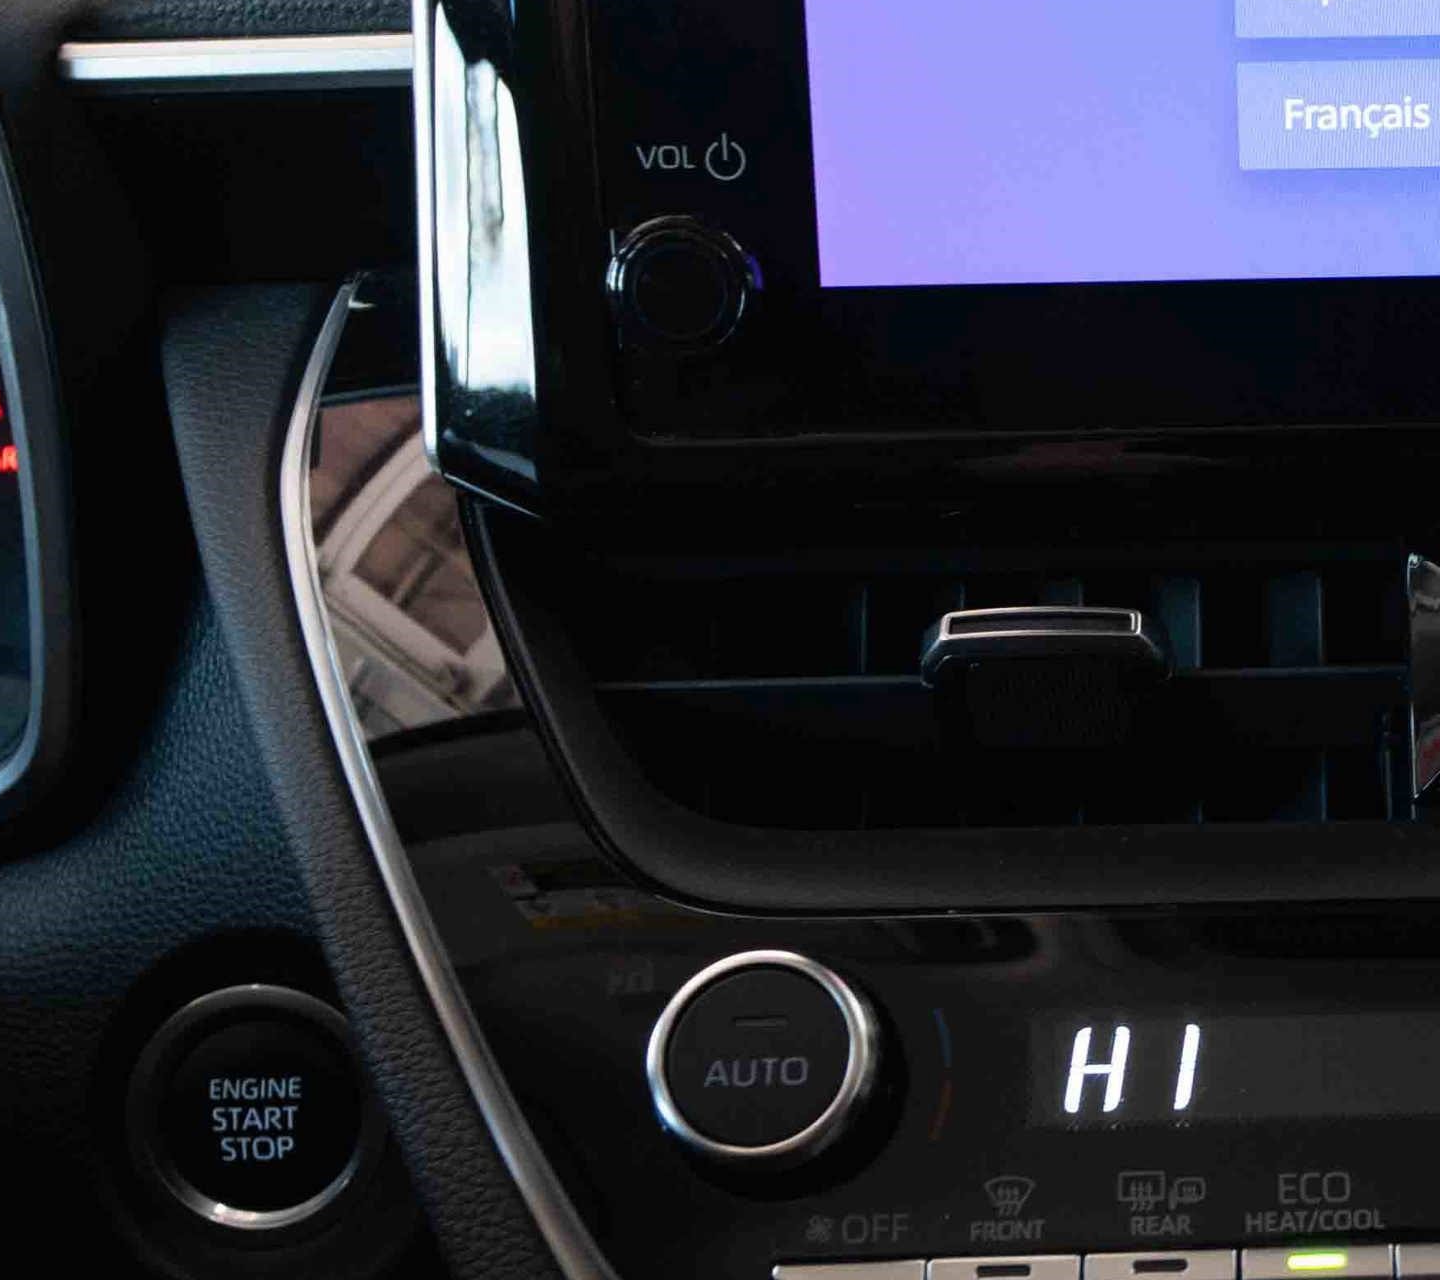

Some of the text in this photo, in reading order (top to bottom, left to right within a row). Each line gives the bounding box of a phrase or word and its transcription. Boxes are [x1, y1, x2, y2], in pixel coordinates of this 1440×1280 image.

[1284, 96, 1431, 138] Français
[635, 144, 696, 170] VOL
[704, 1056, 809, 1088] AUTO
[209, 1077, 302, 1100] ENGINE
[212, 1106, 298, 1131] START
[221, 1136, 294, 1161] STOP
[1278, 1172, 1351, 1205] ECO
[841, 1216, 910, 1244] OFF
[969, 1220, 1046, 1241] FRONT
[1130, 1216, 1192, 1236] REAR
[1245, 1209, 1385, 1233] HEAT/COOL
